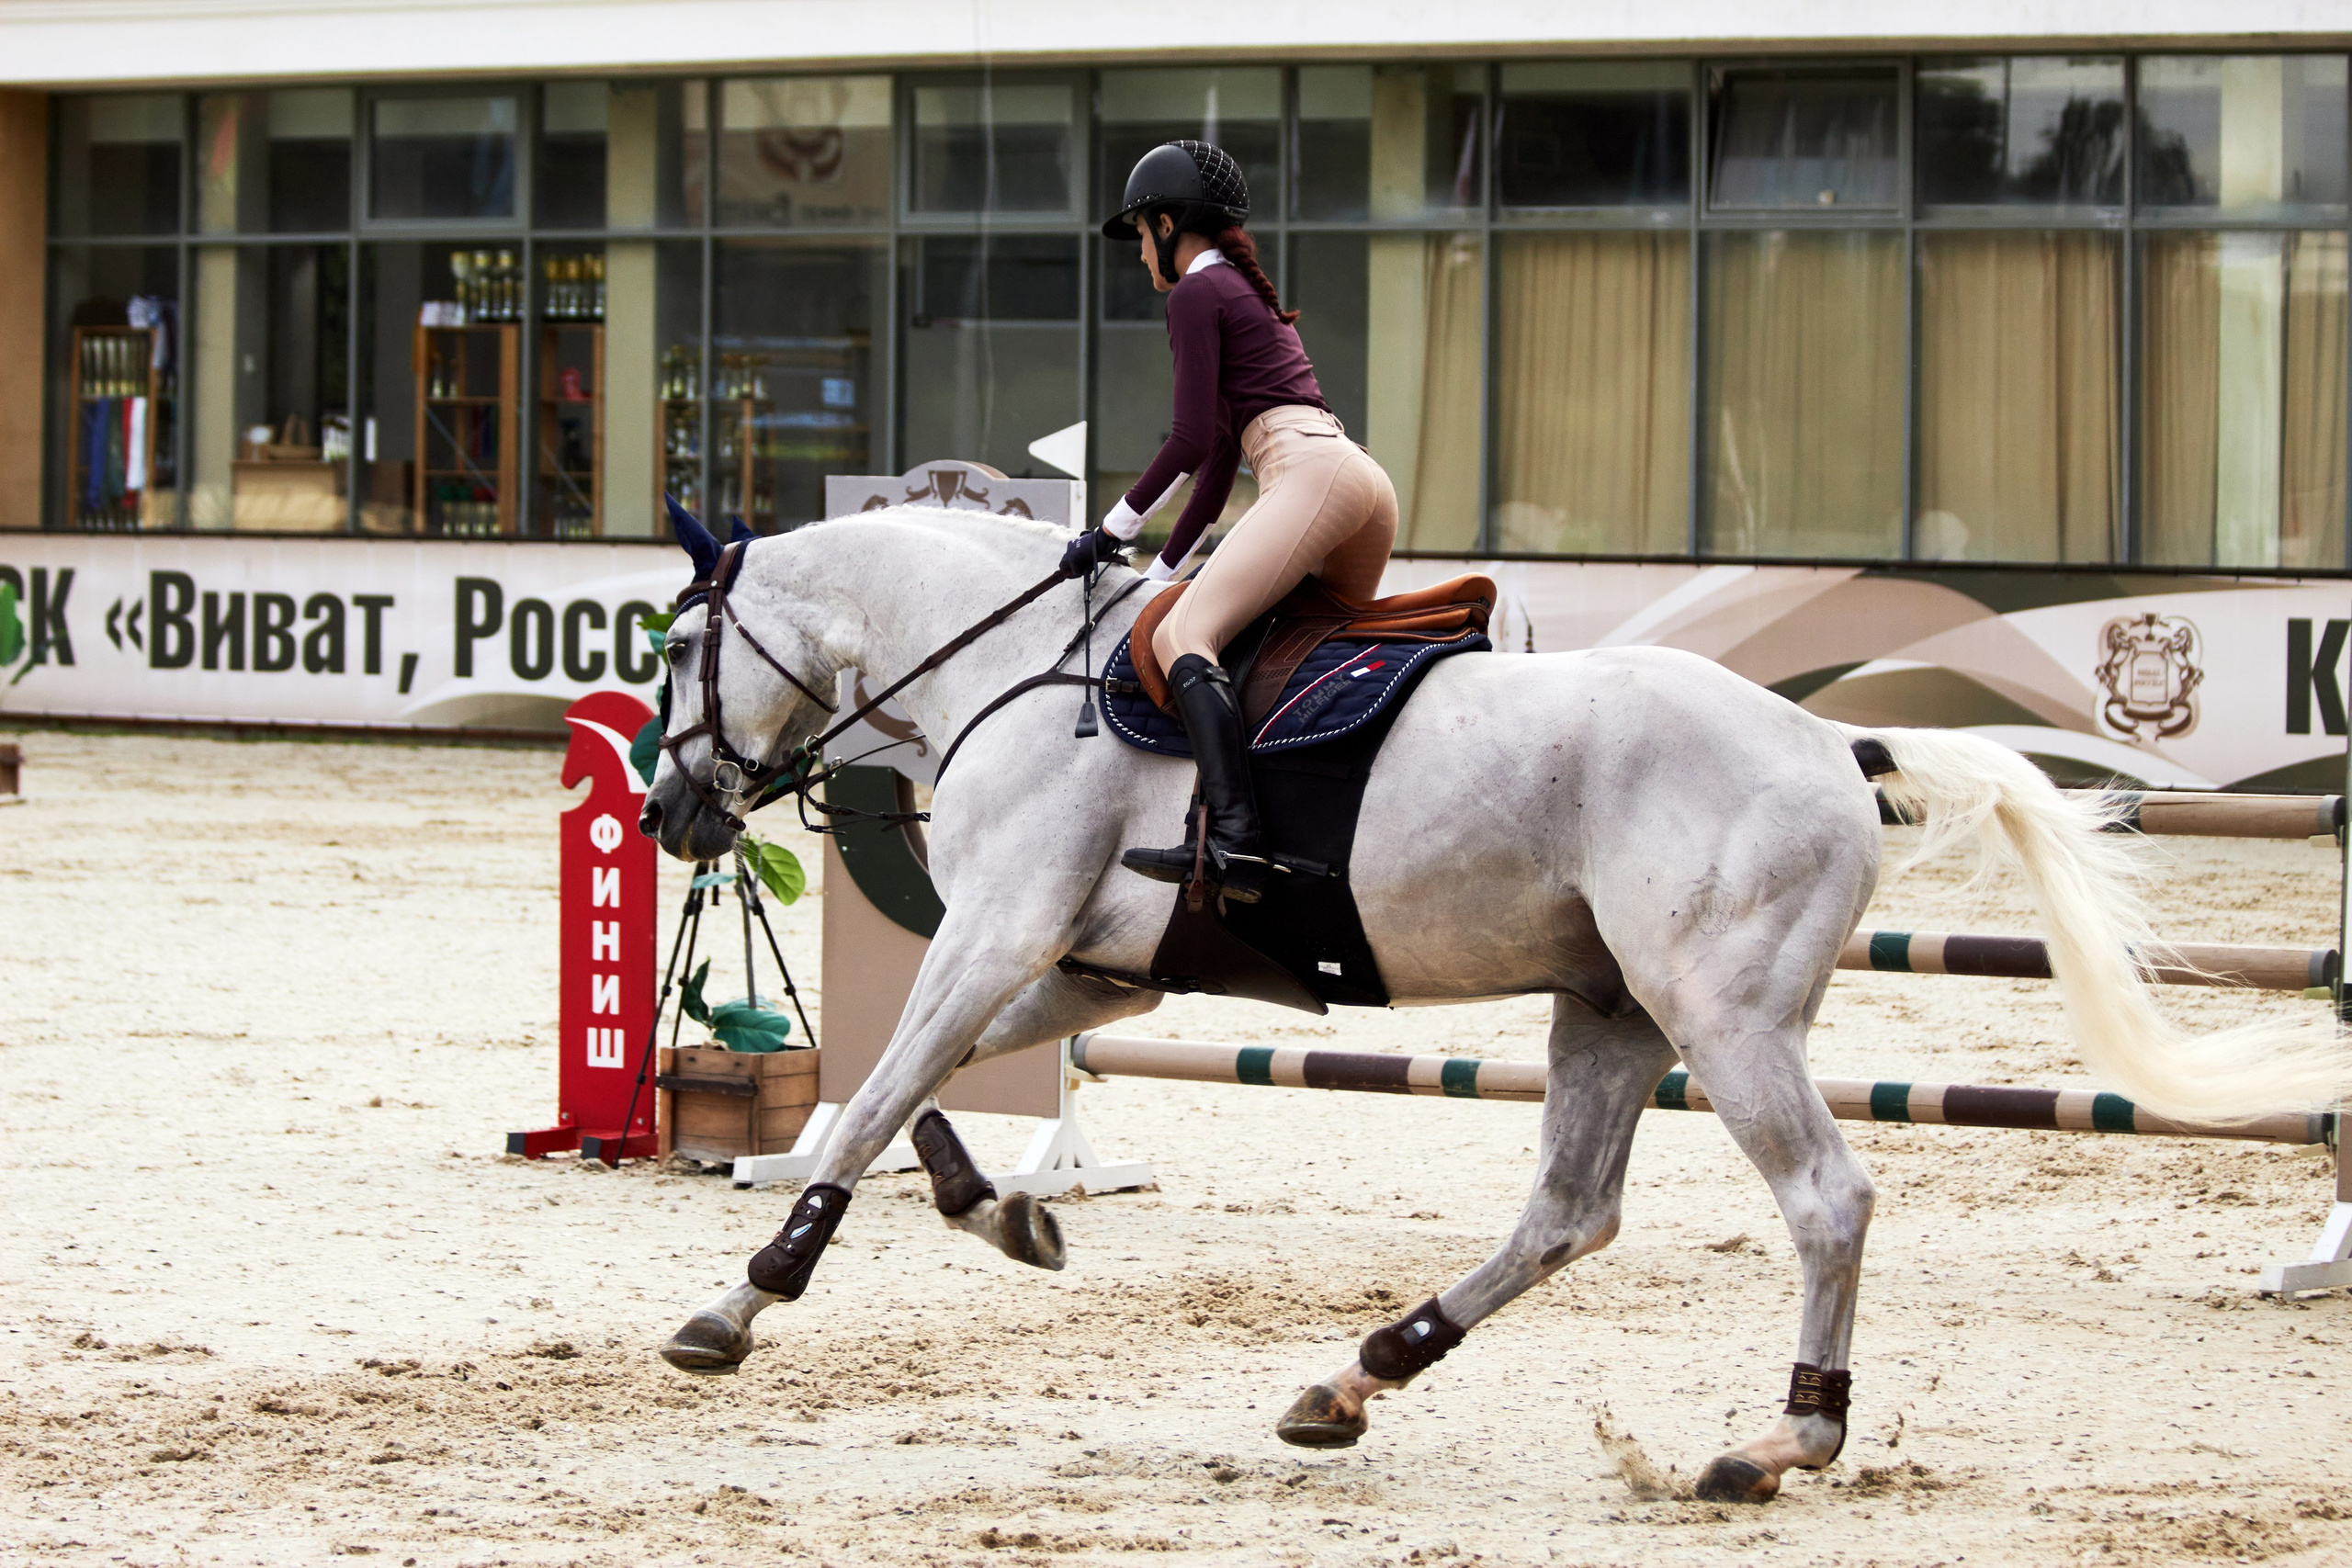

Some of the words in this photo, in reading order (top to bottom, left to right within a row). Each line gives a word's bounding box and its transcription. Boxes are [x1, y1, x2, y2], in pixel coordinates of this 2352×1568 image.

[106, 570, 418, 694] «Виват,
[454, 577, 677, 684] Росс
[1293, 673, 1345, 716] TOMMY
[1298, 680, 1353, 723] HILFIGER
[586, 813, 625, 1069] ФИНИШ
